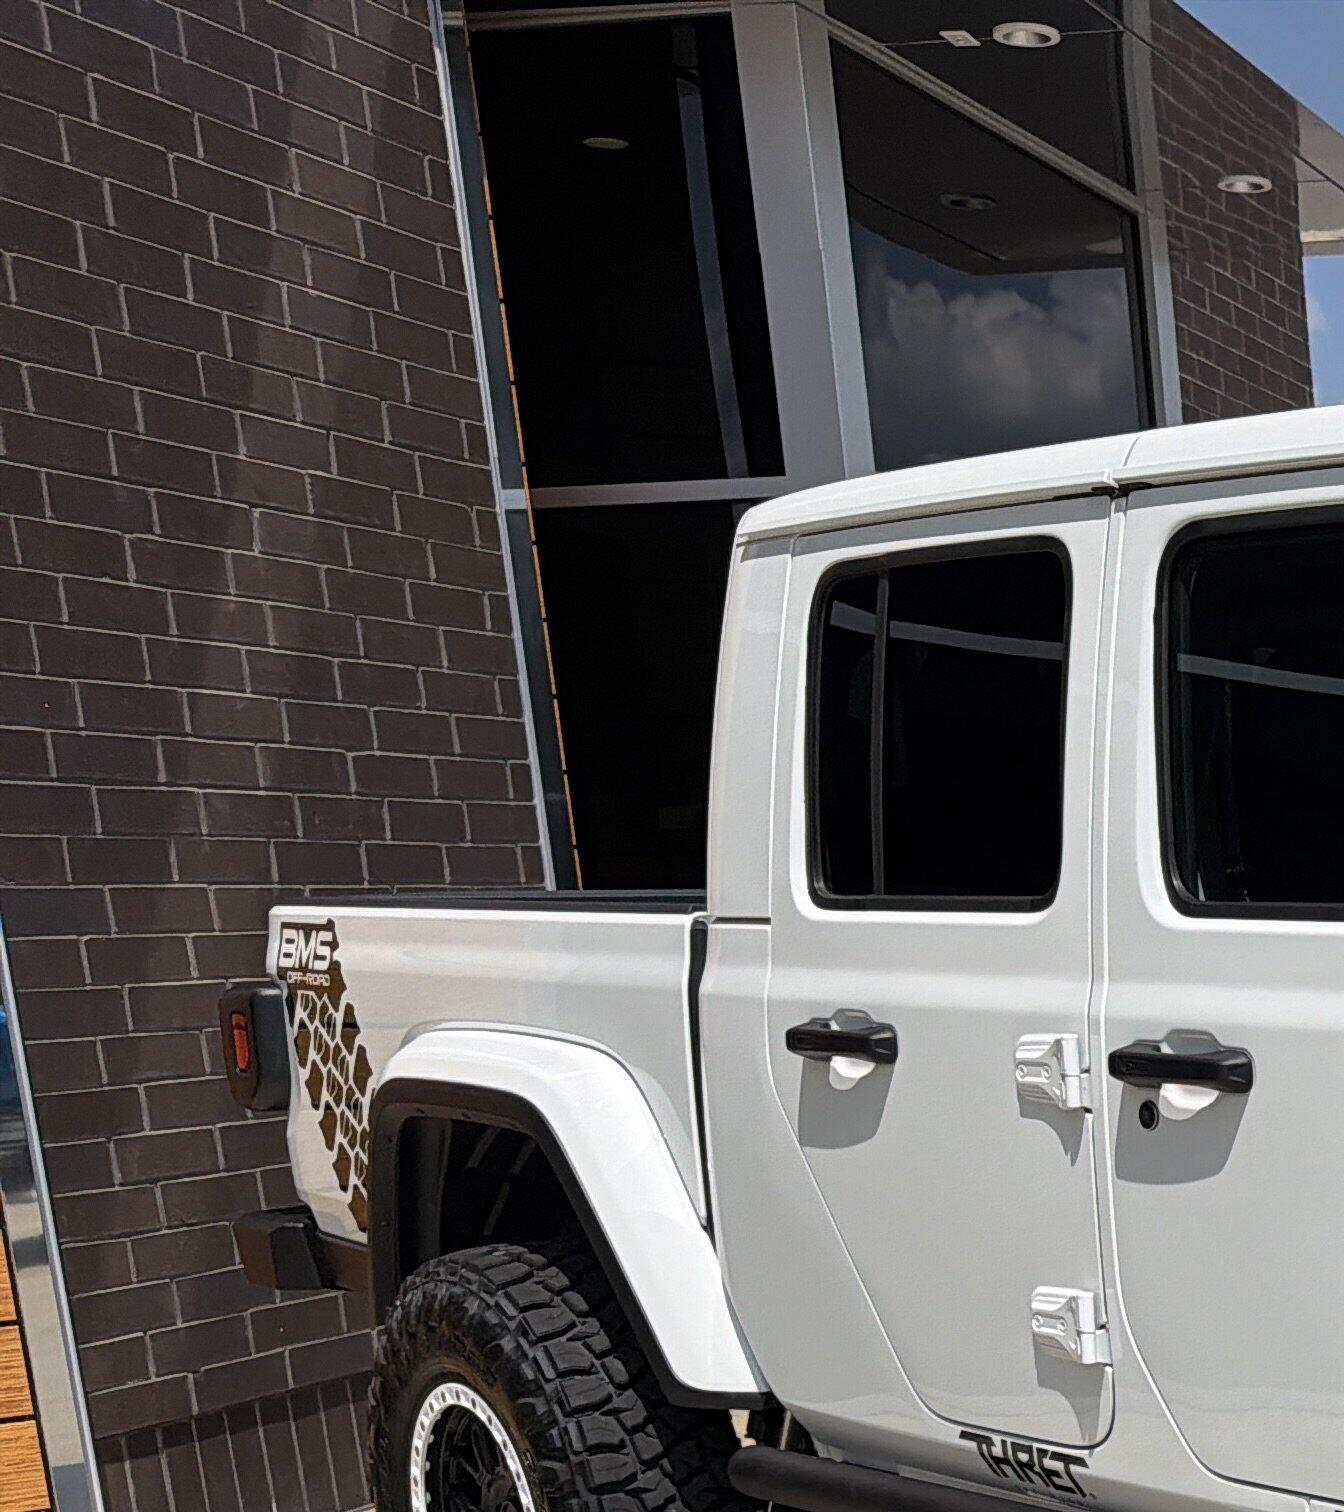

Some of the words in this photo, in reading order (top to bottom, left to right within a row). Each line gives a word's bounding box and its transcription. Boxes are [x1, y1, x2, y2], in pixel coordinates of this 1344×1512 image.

[279, 930, 333, 970] BMS
[286, 973, 330, 986] OFF-ROAD
[959, 1430, 1090, 1498] THRET
